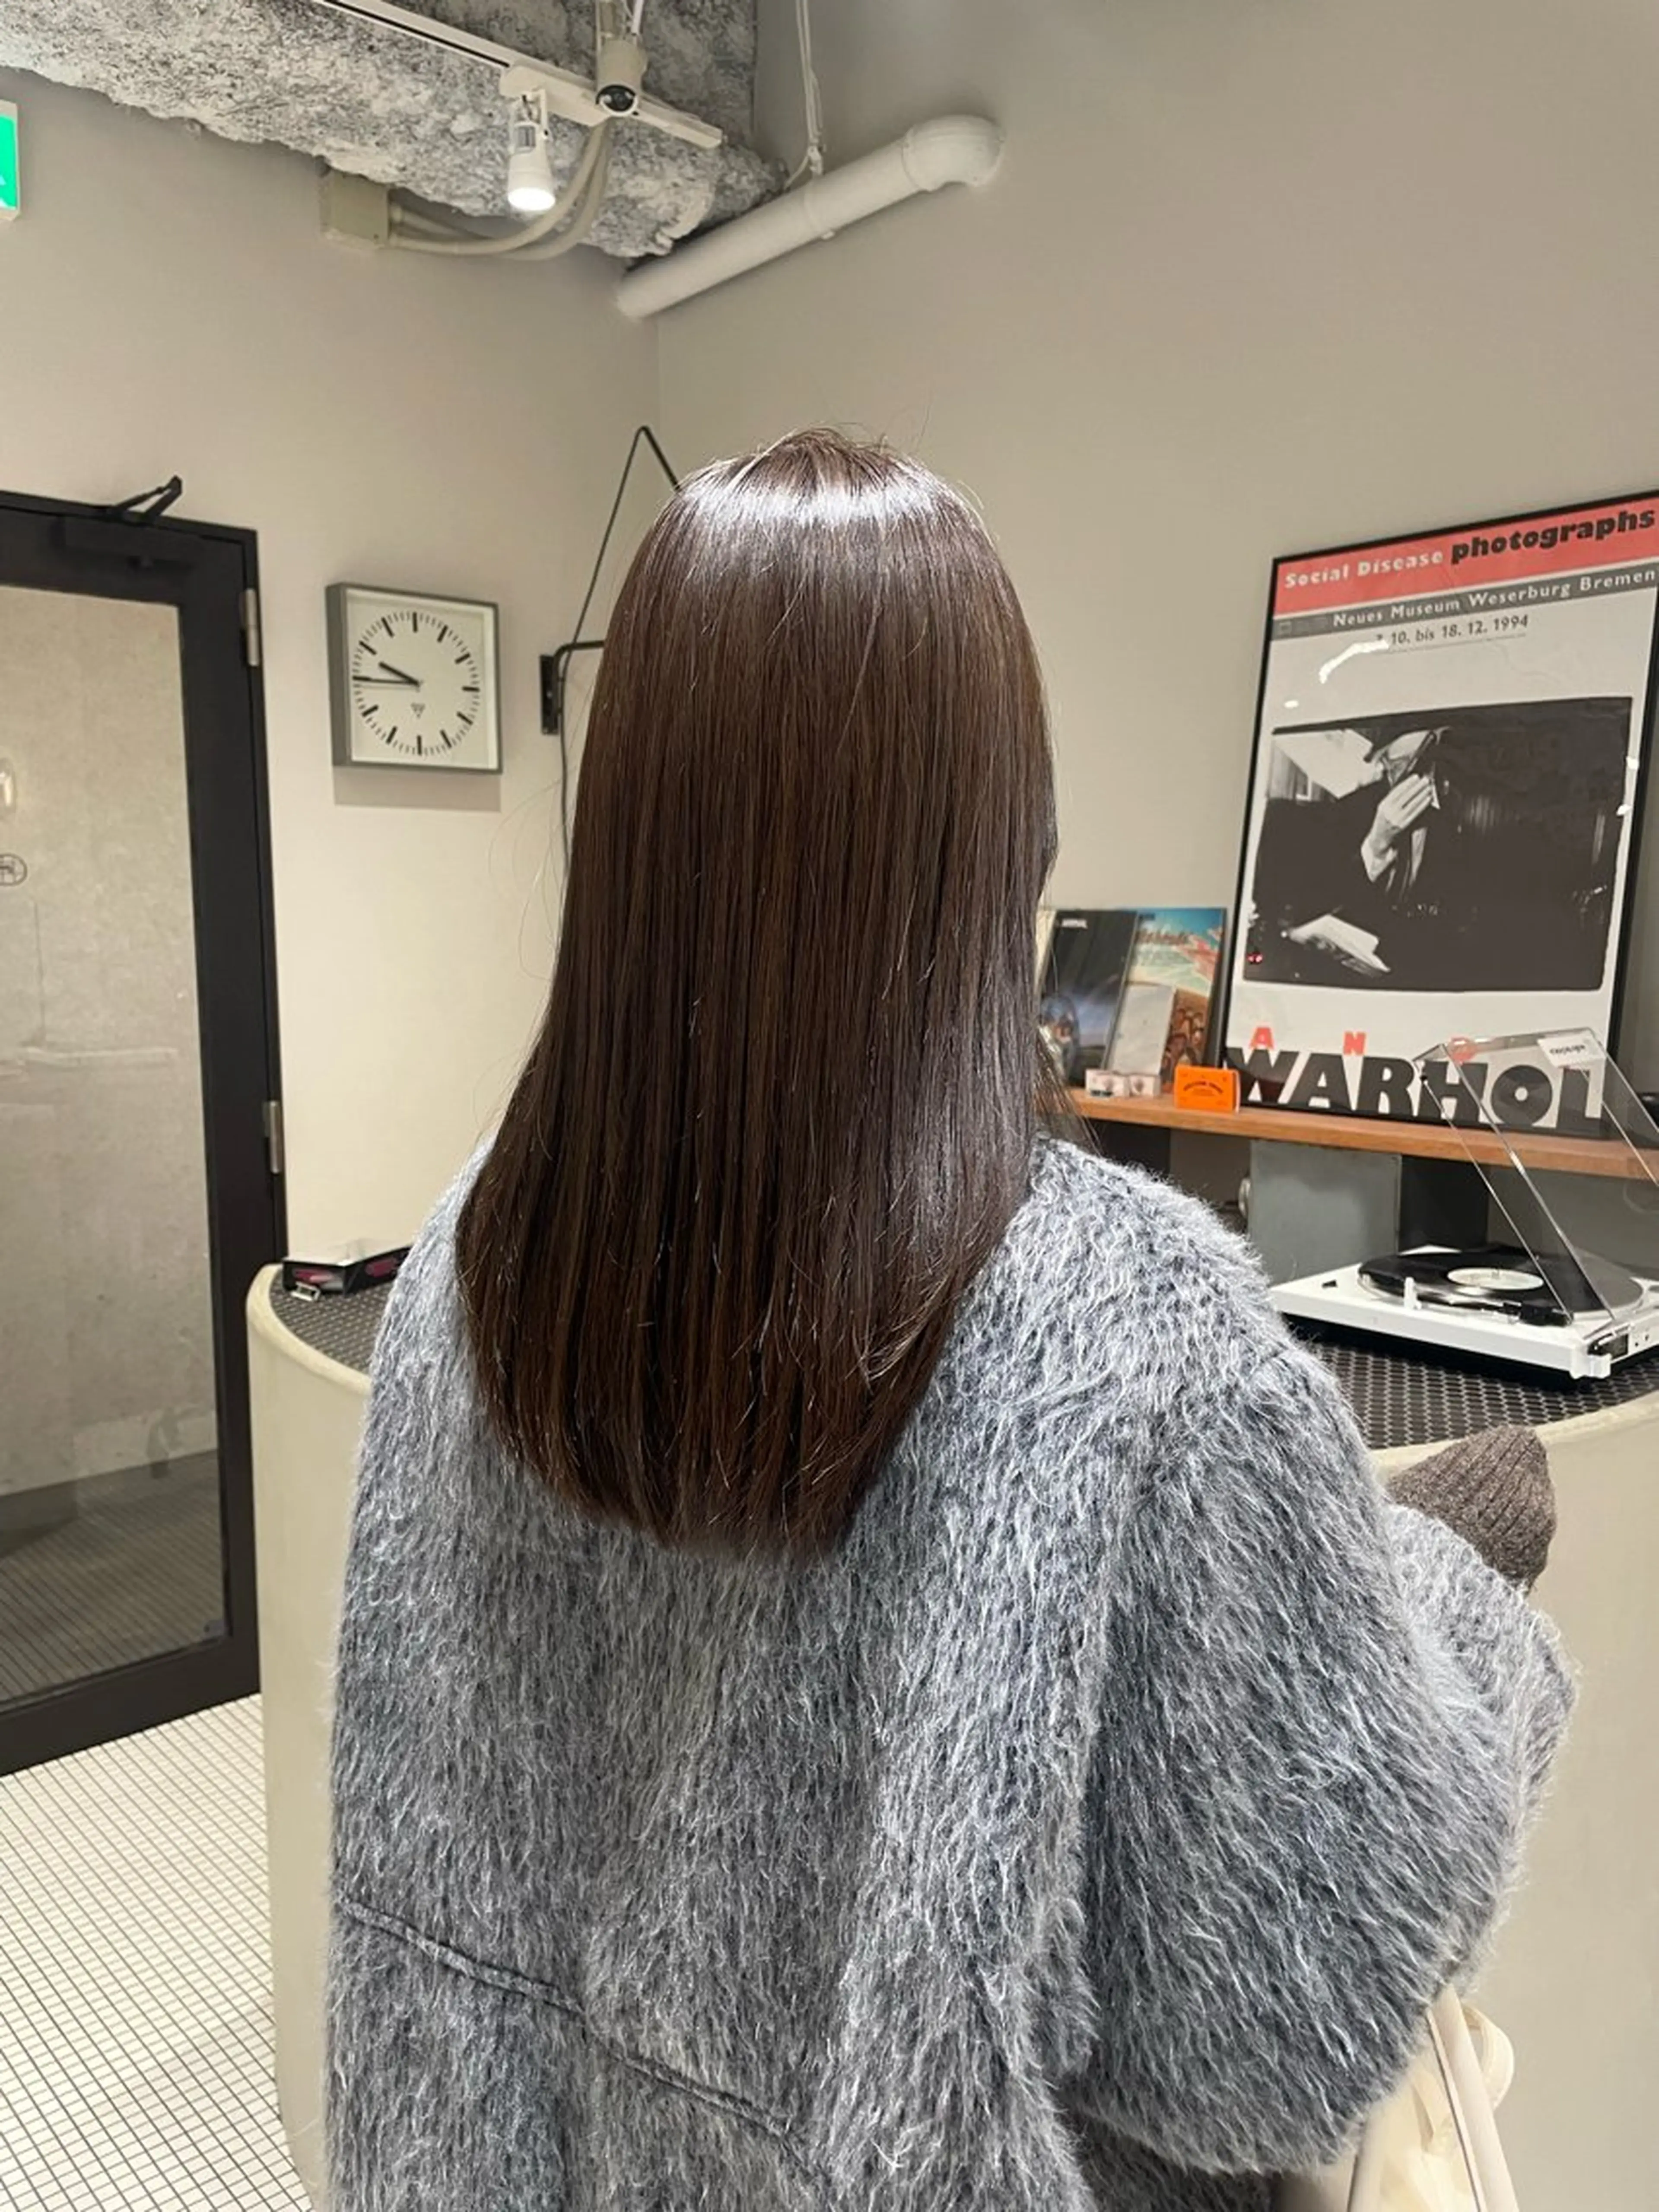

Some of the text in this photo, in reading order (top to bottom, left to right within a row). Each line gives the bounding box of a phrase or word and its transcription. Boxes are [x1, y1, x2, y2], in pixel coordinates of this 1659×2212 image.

[1284, 509, 1655, 588] Social Disease photographs
[1333, 569, 1656, 627] Neues Museum Weserburg Bremen
[1415, 629, 1435, 642] bis
[1493, 614, 1529, 631] 1994
[1226, 1047, 1602, 1129] WARHOL
